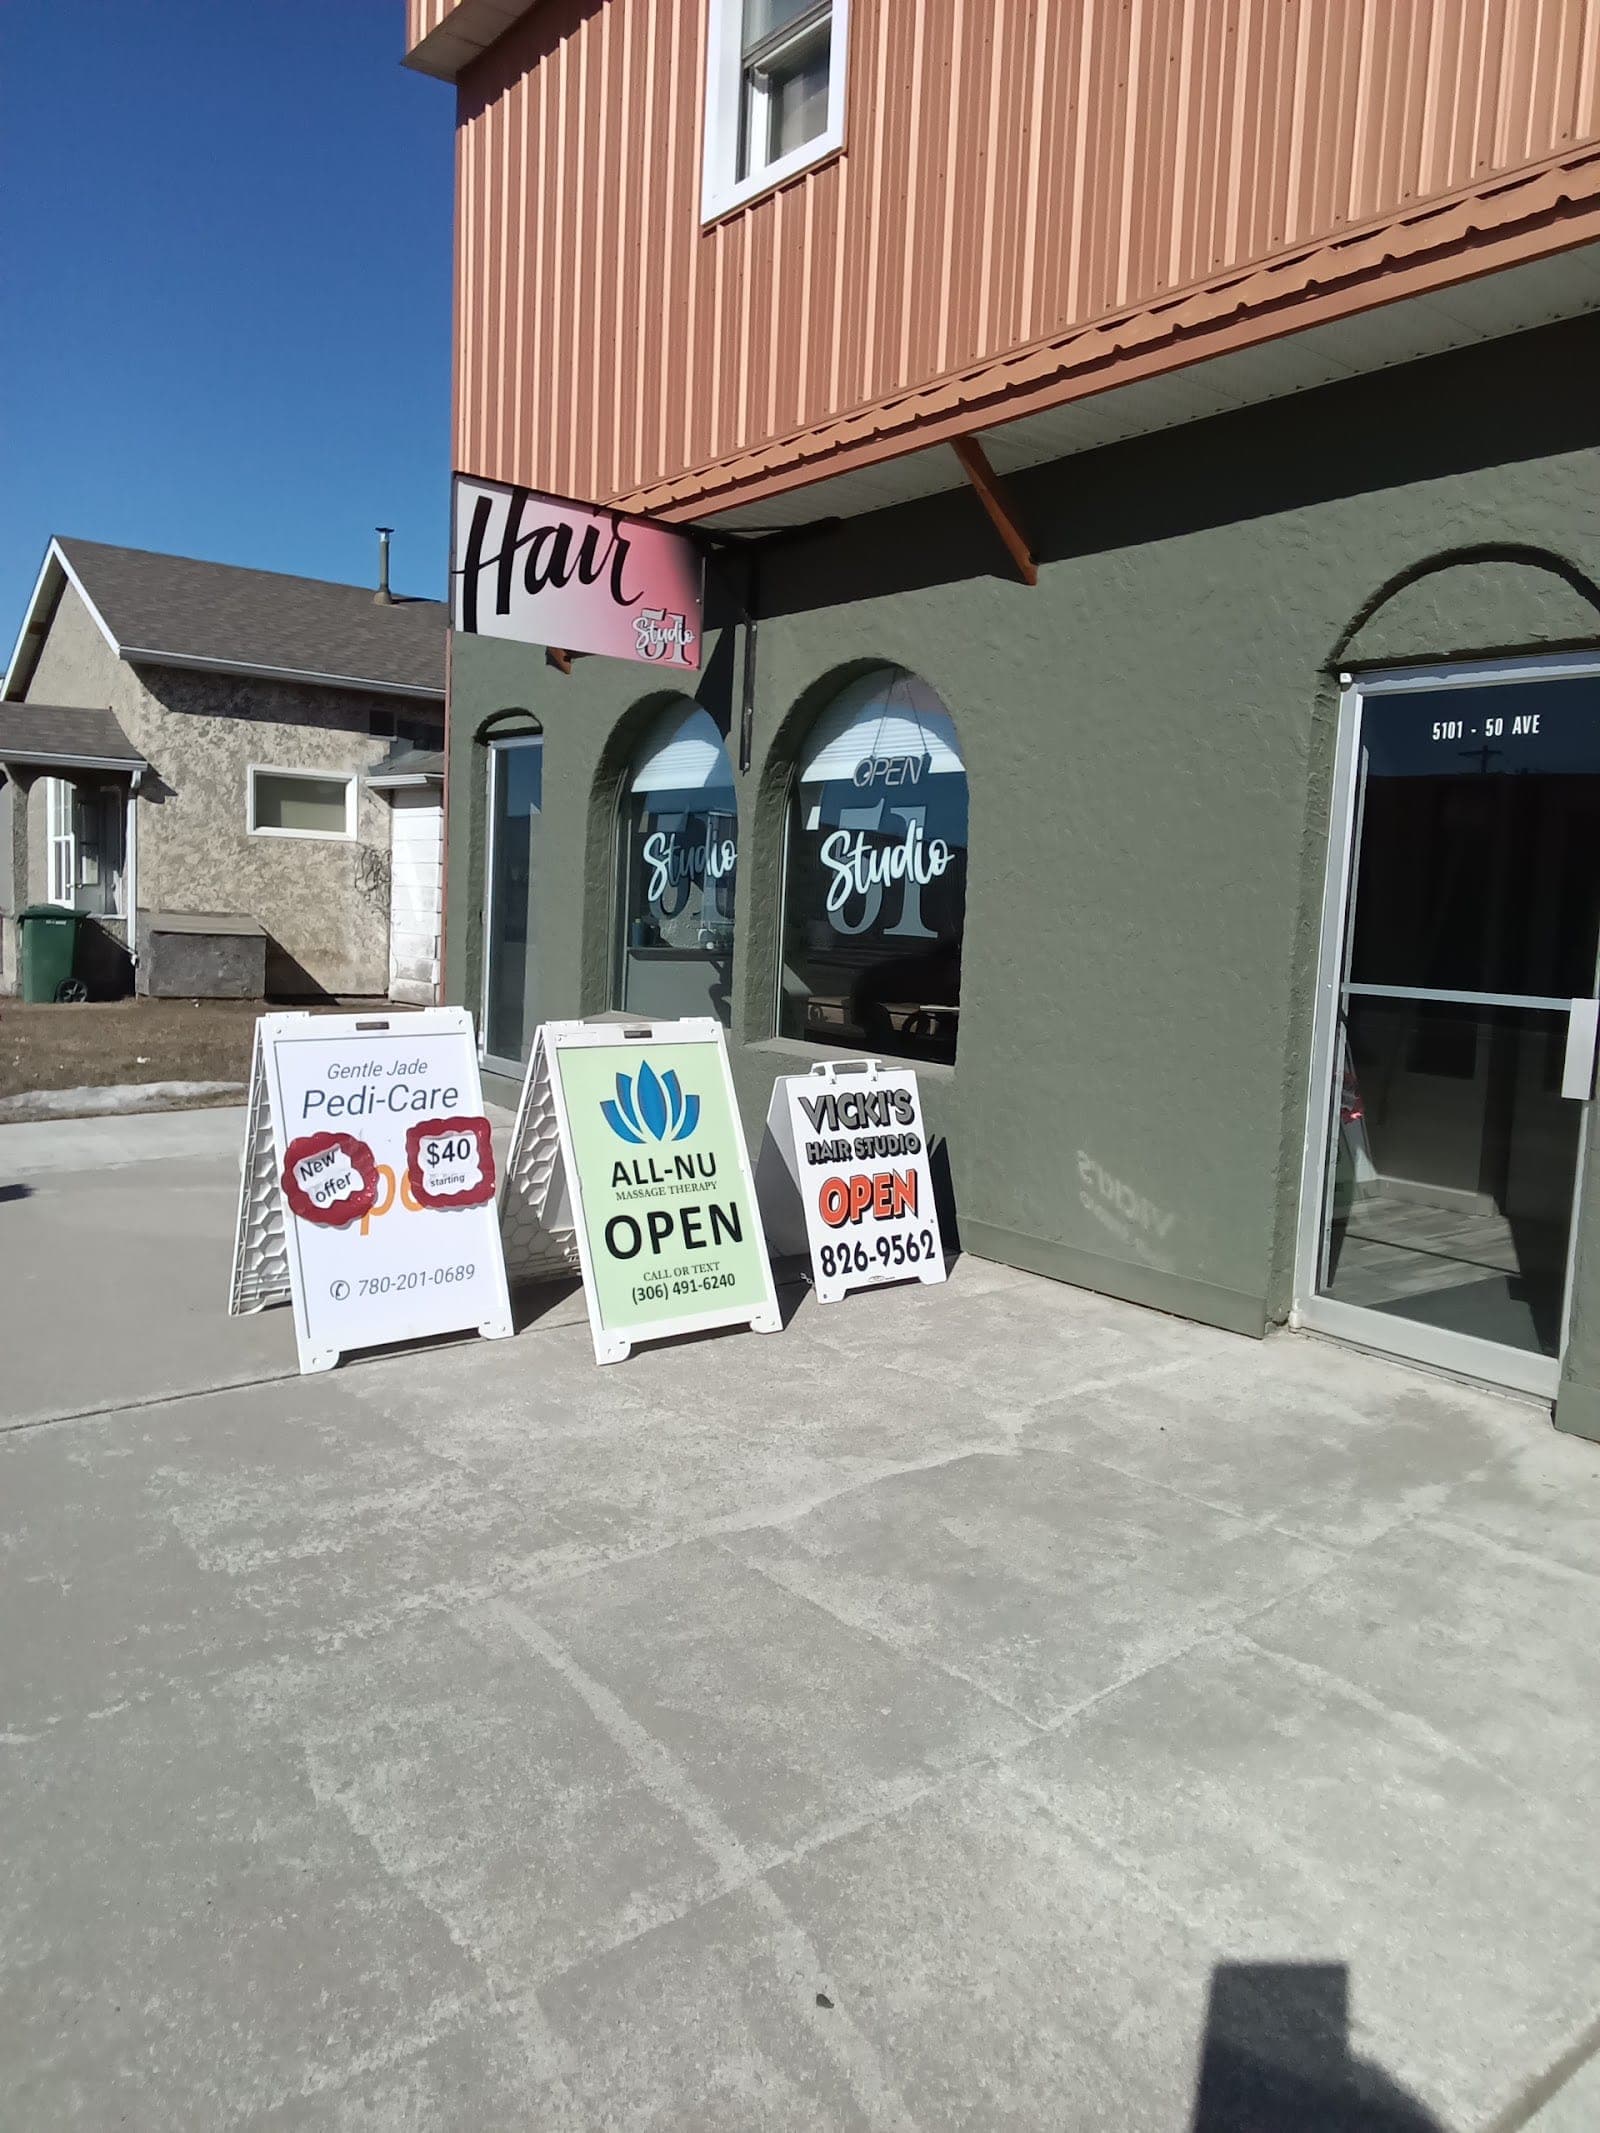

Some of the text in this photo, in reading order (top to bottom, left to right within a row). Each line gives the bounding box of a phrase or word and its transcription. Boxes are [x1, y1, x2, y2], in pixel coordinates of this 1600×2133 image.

[452, 487, 644, 634] Hair
[632, 608, 695, 665] Studio 51
[1432, 721, 1463, 740] 5101
[1485, 718, 1503, 737] 50
[1512, 714, 1541, 735] AVE
[852, 756, 923, 788] OPEN
[643, 832, 738, 902] Studio
[820, 798, 955, 939] Studio 51
[328, 1058, 429, 1080] Gentle Jade
[302, 1083, 459, 1119] Pedi-Care
[798, 1088, 915, 1134] VICKI'S
[427, 1138, 471, 1168] $40
[805, 1132, 921, 1165] HAIR STUDIO
[300, 1150, 336, 1182] New
[430, 1175, 466, 1187] starting
[611, 1152, 717, 1188] ALL-NU
[315, 1172, 351, 1203] offer
[616, 1181, 717, 1201] MASSAGE THERAPY
[819, 1168, 918, 1229] OPEN
[604, 1202, 743, 1260] OPEN
[820, 1229, 935, 1277] 826-9562
[358, 1263, 476, 1297] 780-201-0689
[643, 1261, 720, 1282] CALL OR TEXT
[632, 1273, 736, 1306] (306) 491-6240
